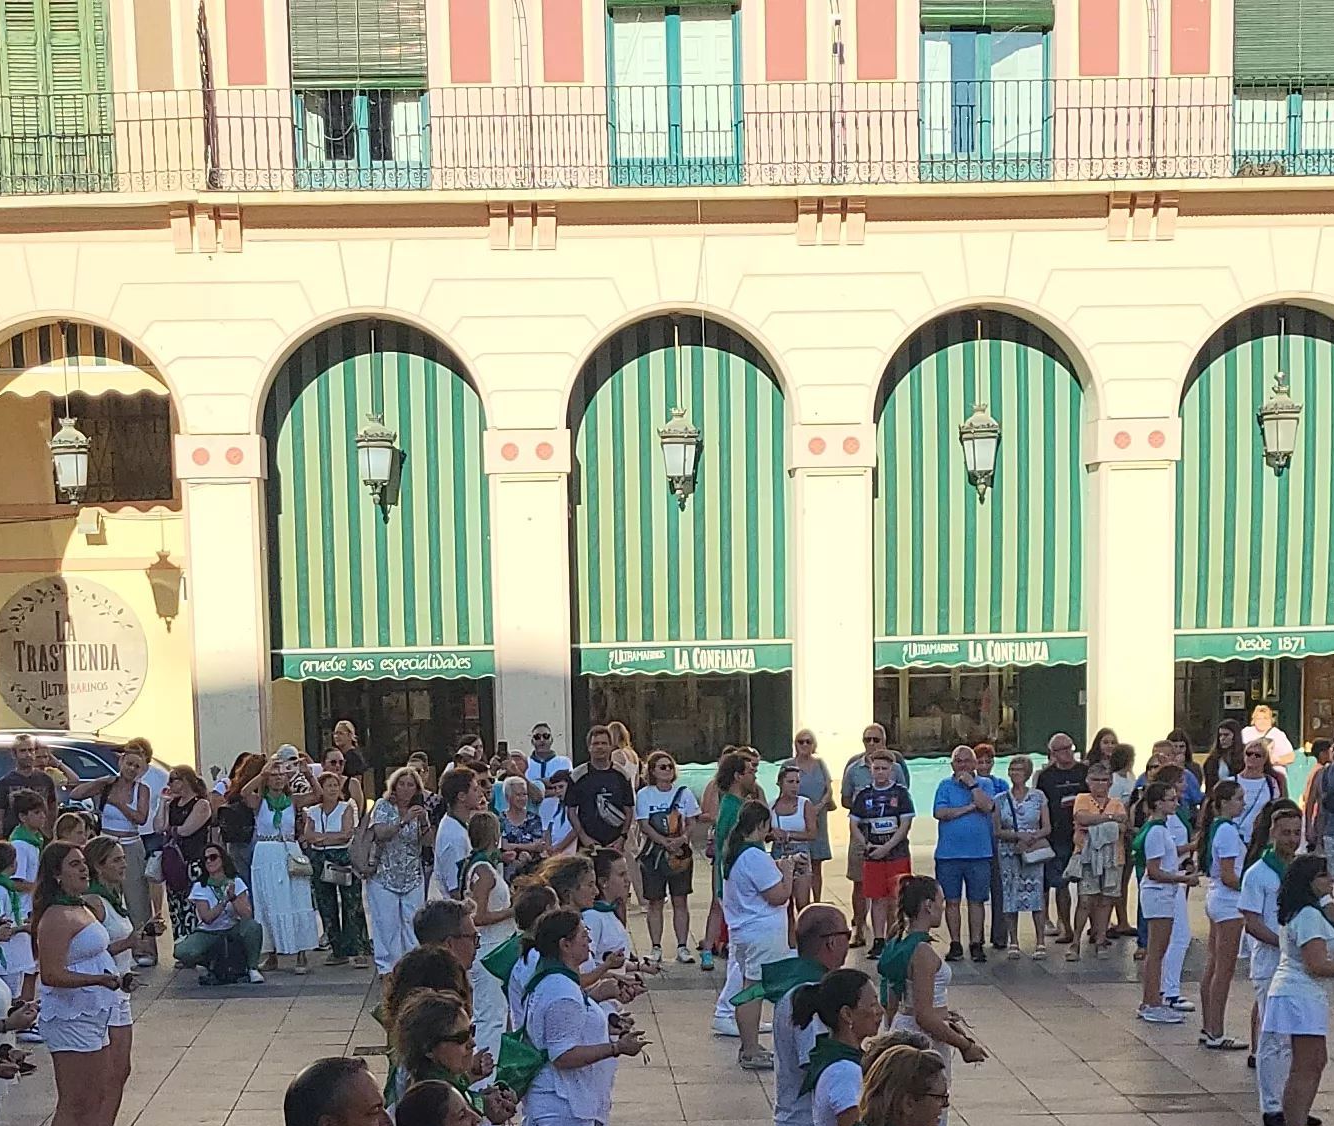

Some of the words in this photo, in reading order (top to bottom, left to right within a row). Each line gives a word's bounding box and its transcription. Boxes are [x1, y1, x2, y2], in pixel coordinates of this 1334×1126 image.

[55, 610, 77, 642] LA
[968, 640, 984, 662] LA
[986, 640, 1049, 662] CONFIANZA
[1235, 634, 1272, 651] desde
[1277, 636, 1305, 652] 1871
[13, 640, 120, 673] TRASTIENDA
[299, 655, 347, 677] pruebe
[352, 657, 374, 671] sus
[380, 653, 472, 676] especialidades
[674, 647, 690, 670] LA
[692, 647, 755, 670] CONFIANZA
[41, 680, 109, 701] ULTRABARINOS
